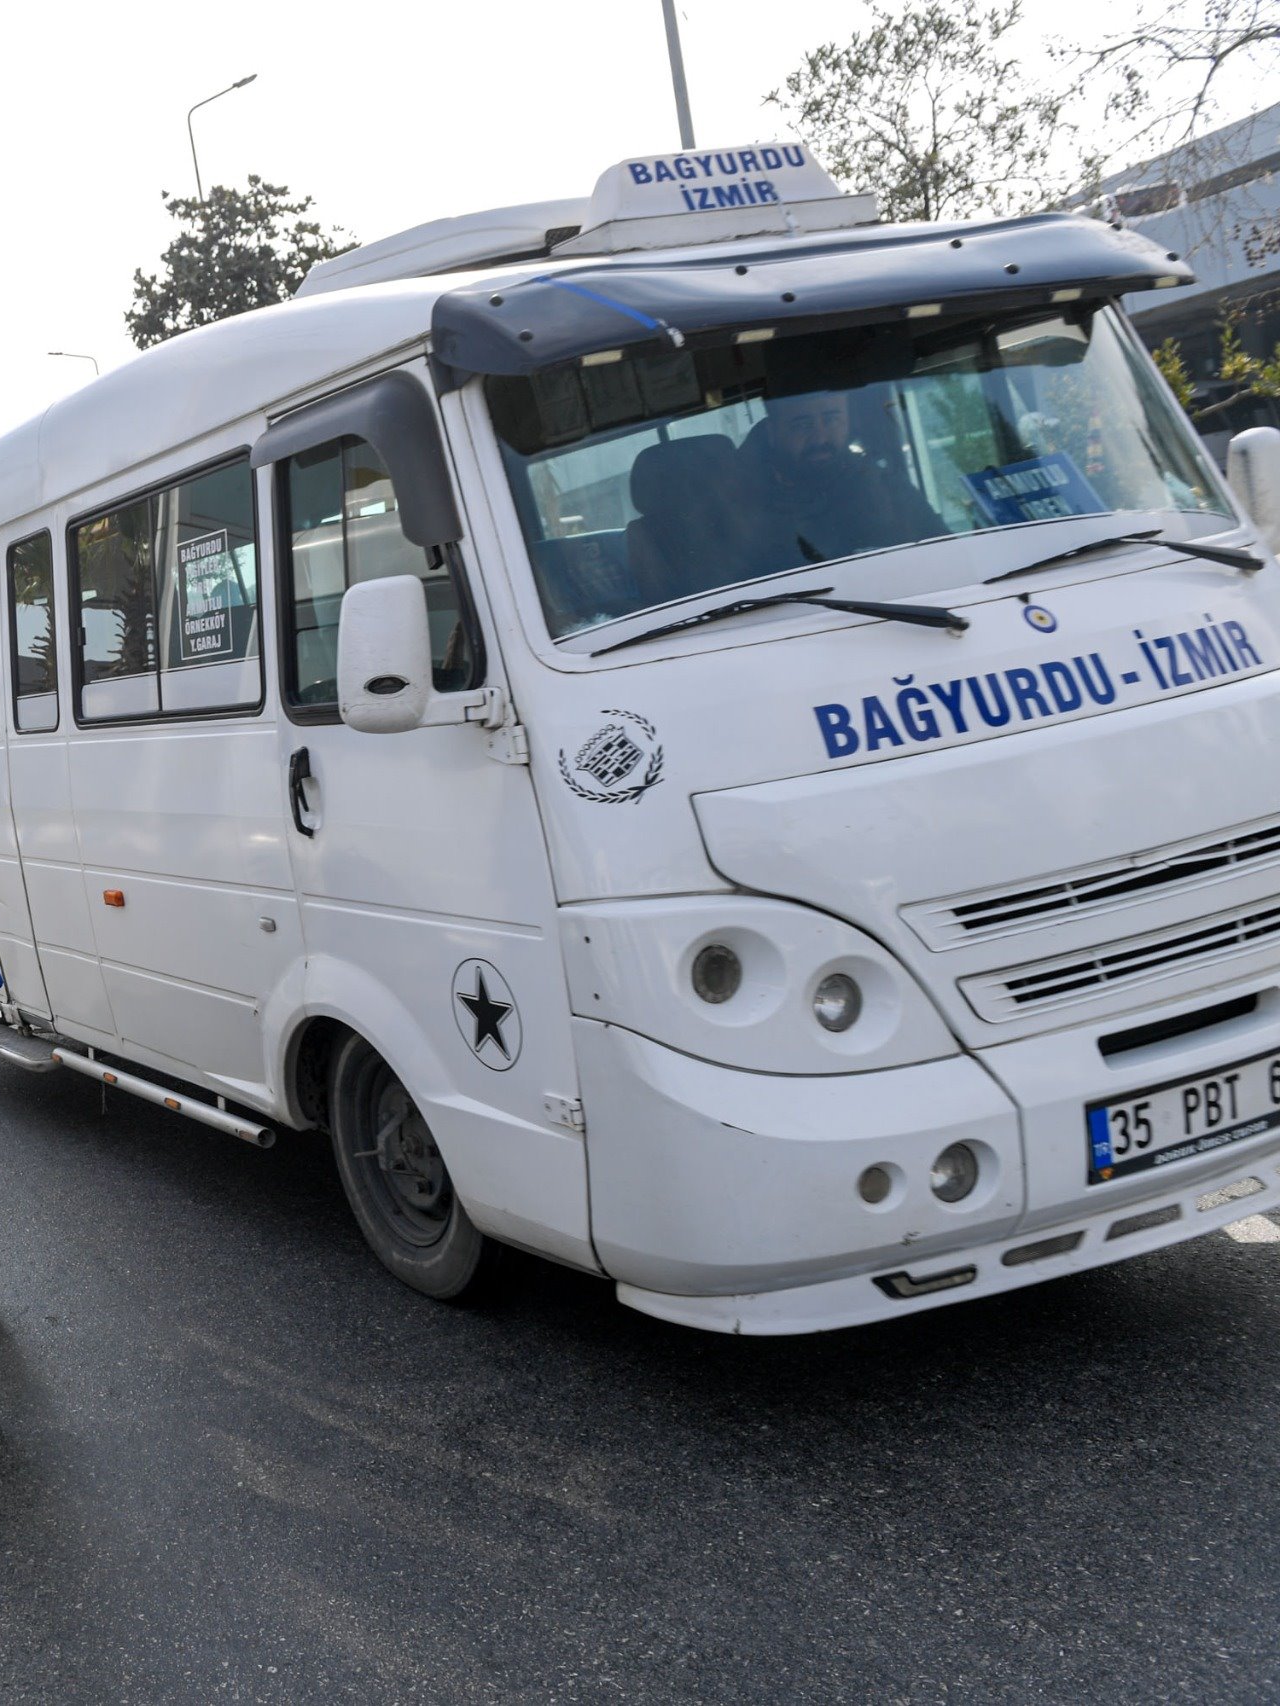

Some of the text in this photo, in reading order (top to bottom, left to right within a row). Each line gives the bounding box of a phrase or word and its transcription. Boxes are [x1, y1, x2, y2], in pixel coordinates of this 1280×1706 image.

[628, 144, 806, 185] BAĞYURDU
[680, 177, 779, 211] İZMİR
[182, 538, 222, 562] BAĞYURDU
[185, 612, 225, 635] ÖRNEKKÖY
[190, 634, 221, 653] Y.GARAJ
[1111, 1102, 1152, 1154] 35
[1183, 1073, 1241, 1135] PBT
